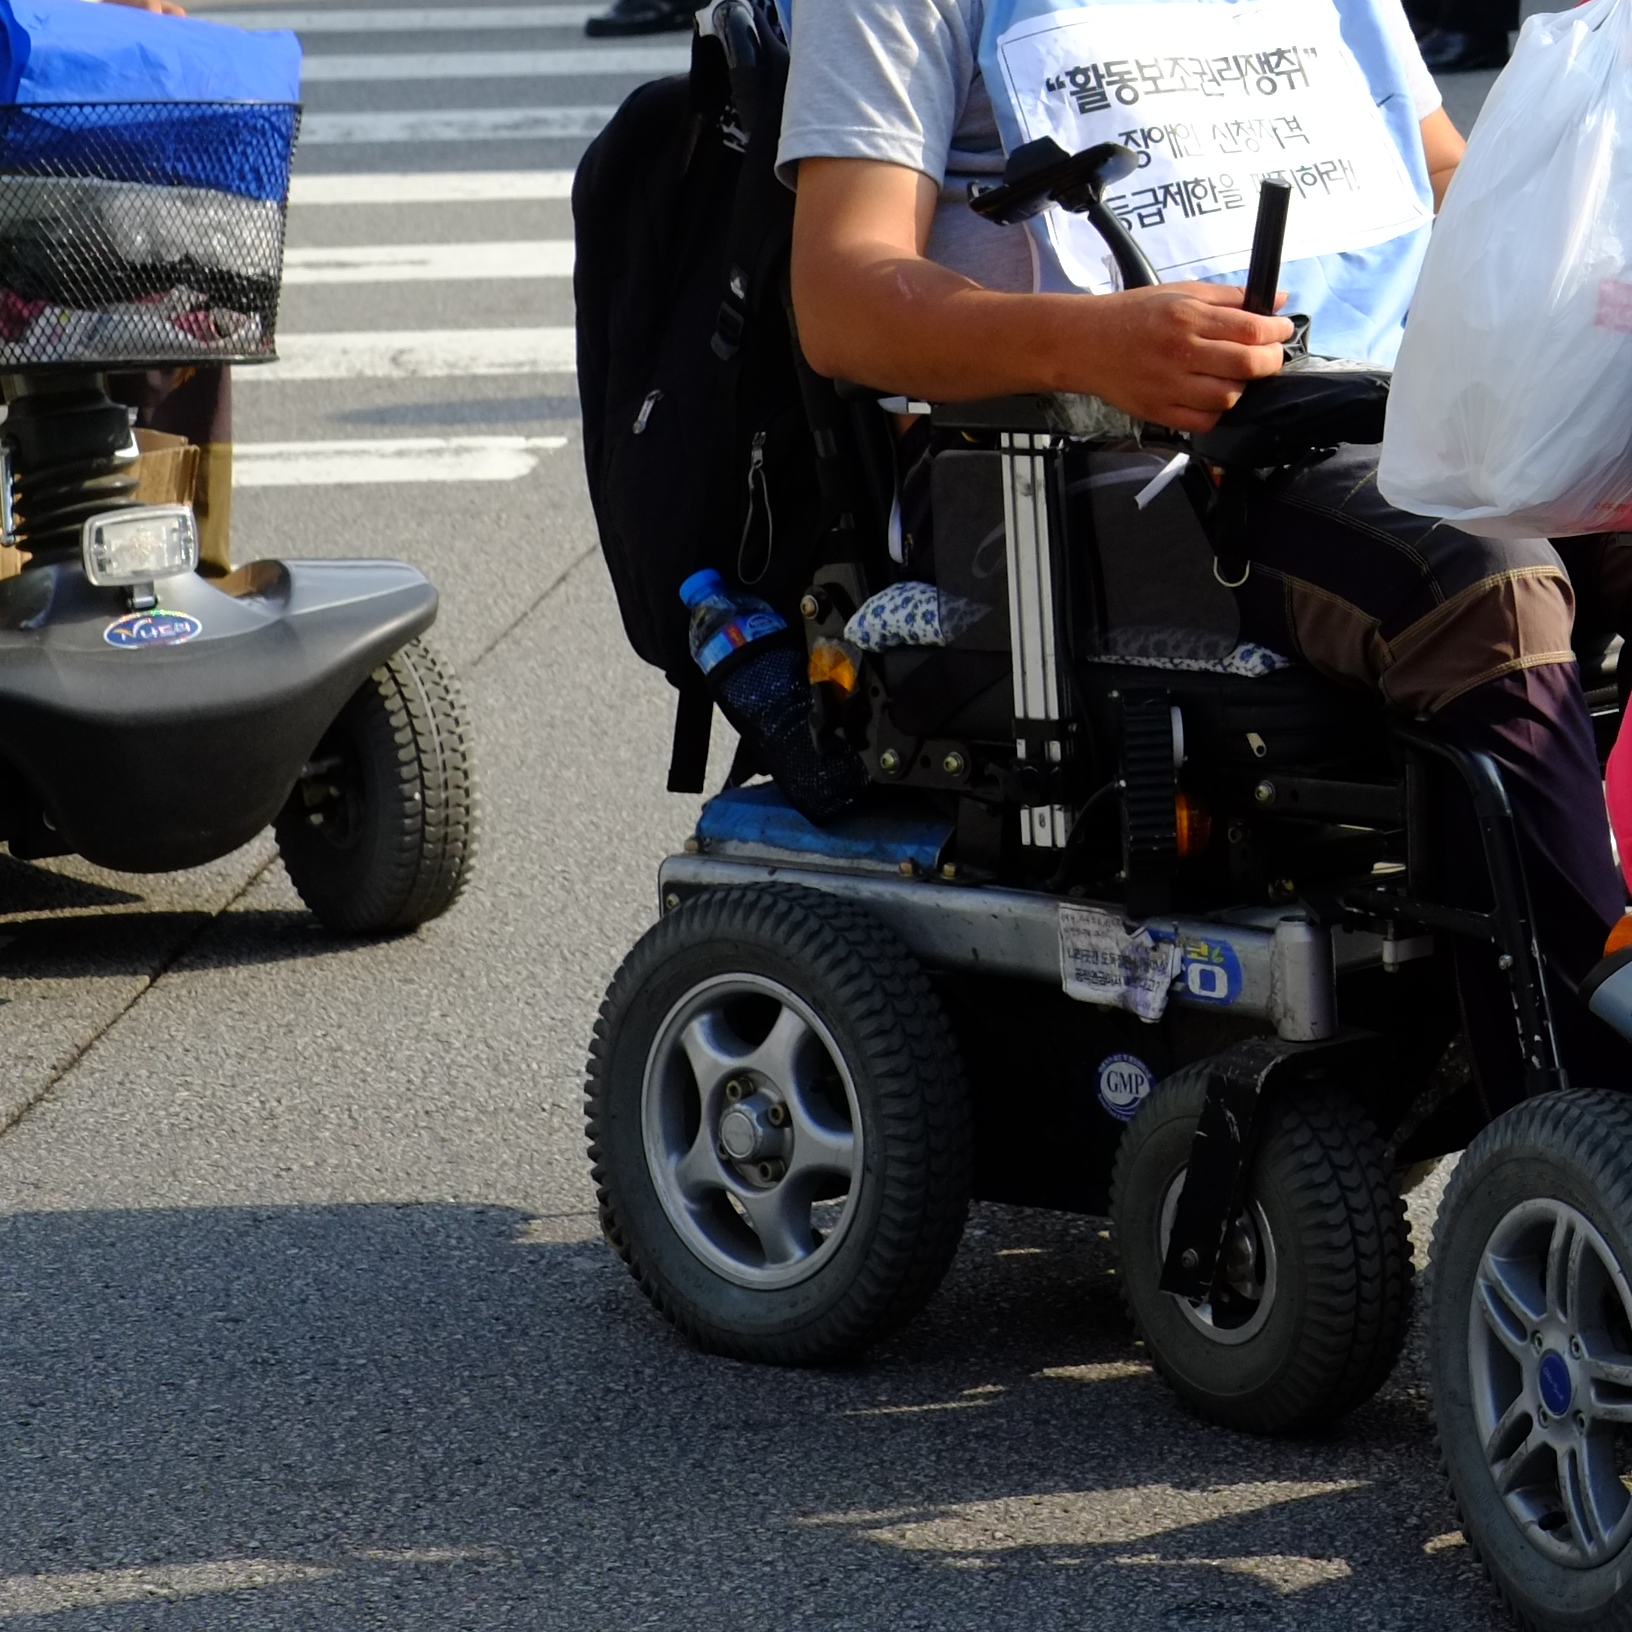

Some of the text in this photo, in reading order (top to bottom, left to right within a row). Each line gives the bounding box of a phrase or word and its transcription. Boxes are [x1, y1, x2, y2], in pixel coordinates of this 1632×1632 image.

[1118, 116, 1311, 169] 장애인 신청자격
[1106, 1070, 1146, 1096] GMP
